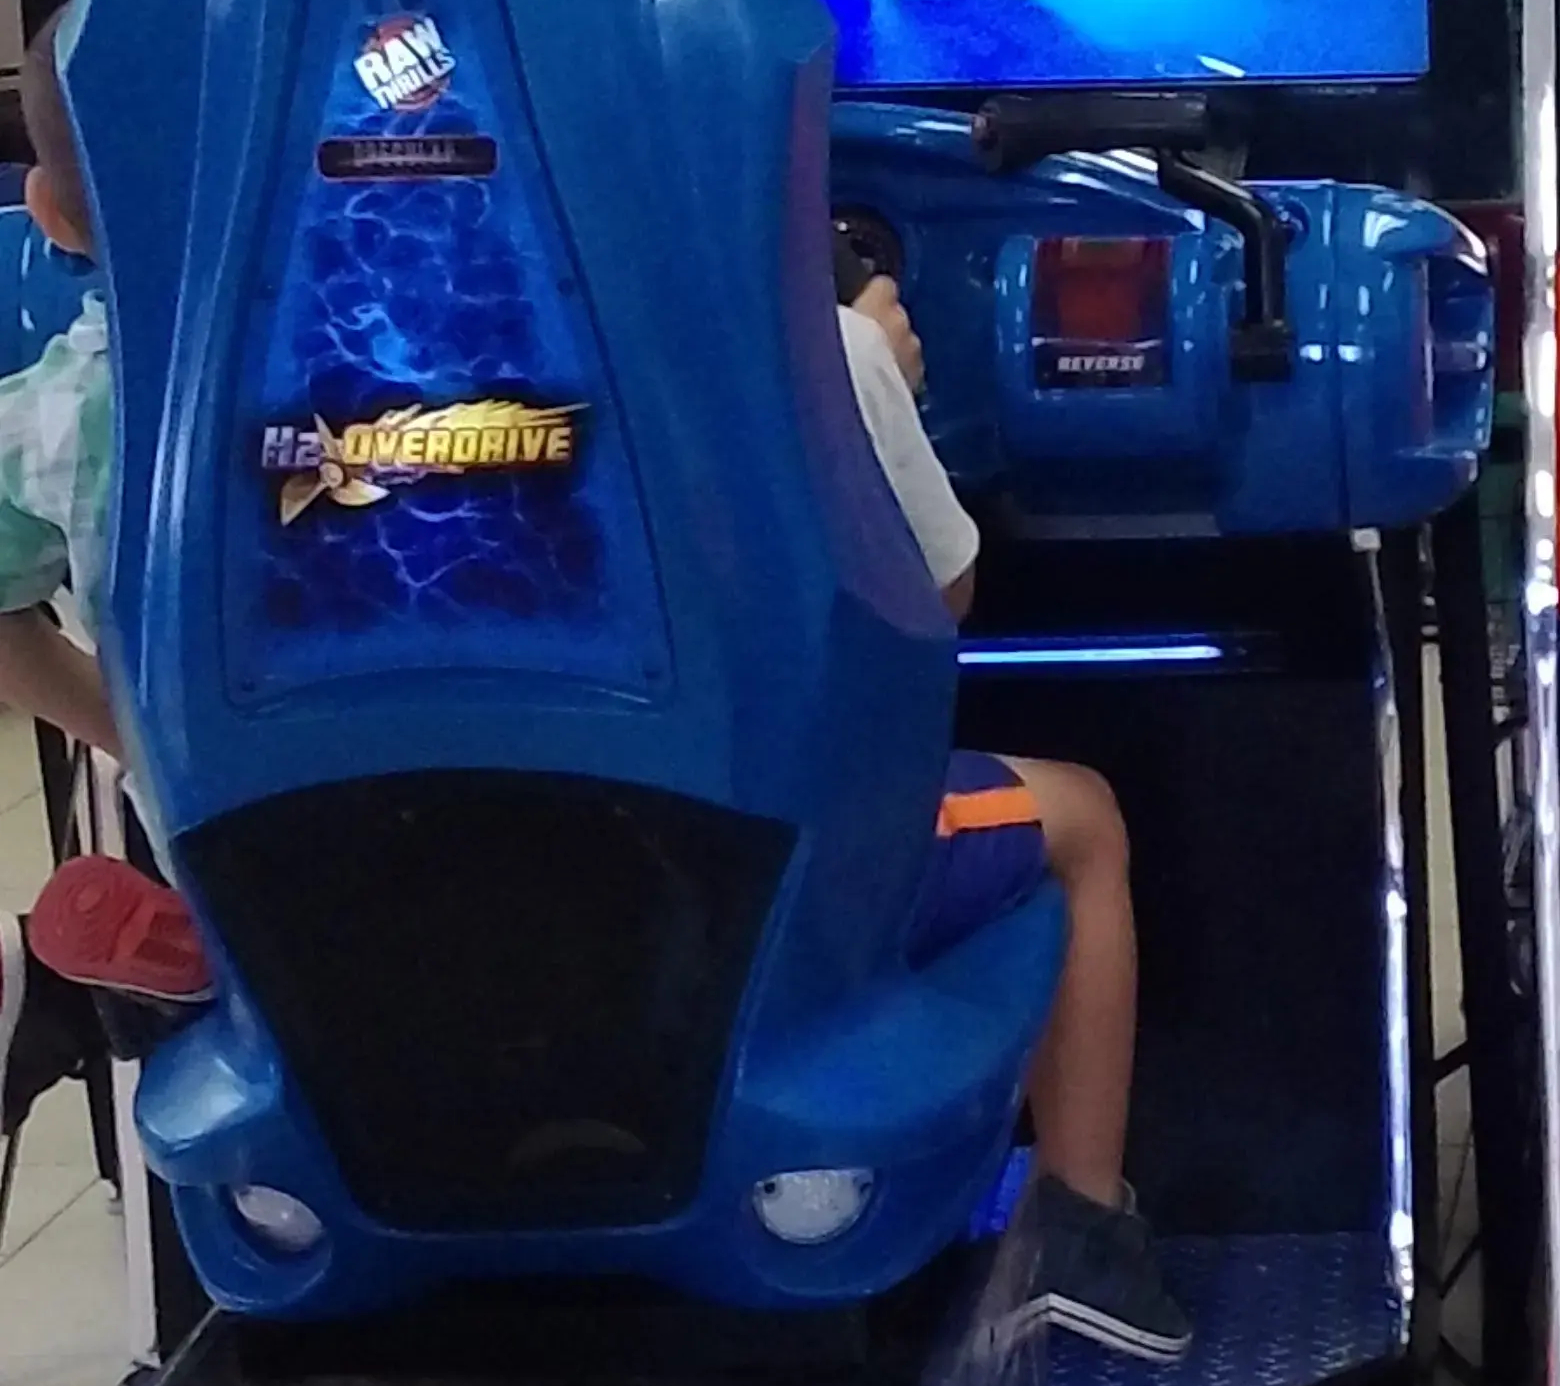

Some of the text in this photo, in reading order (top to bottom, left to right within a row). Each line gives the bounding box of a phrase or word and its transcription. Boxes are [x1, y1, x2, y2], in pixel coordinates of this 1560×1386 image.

[353, 16, 448, 91] RAW
[374, 50, 457, 110] THRILLS
[1057, 355, 1145, 372] REVERSE
[343, 424, 573, 465] OVERDRIVE
